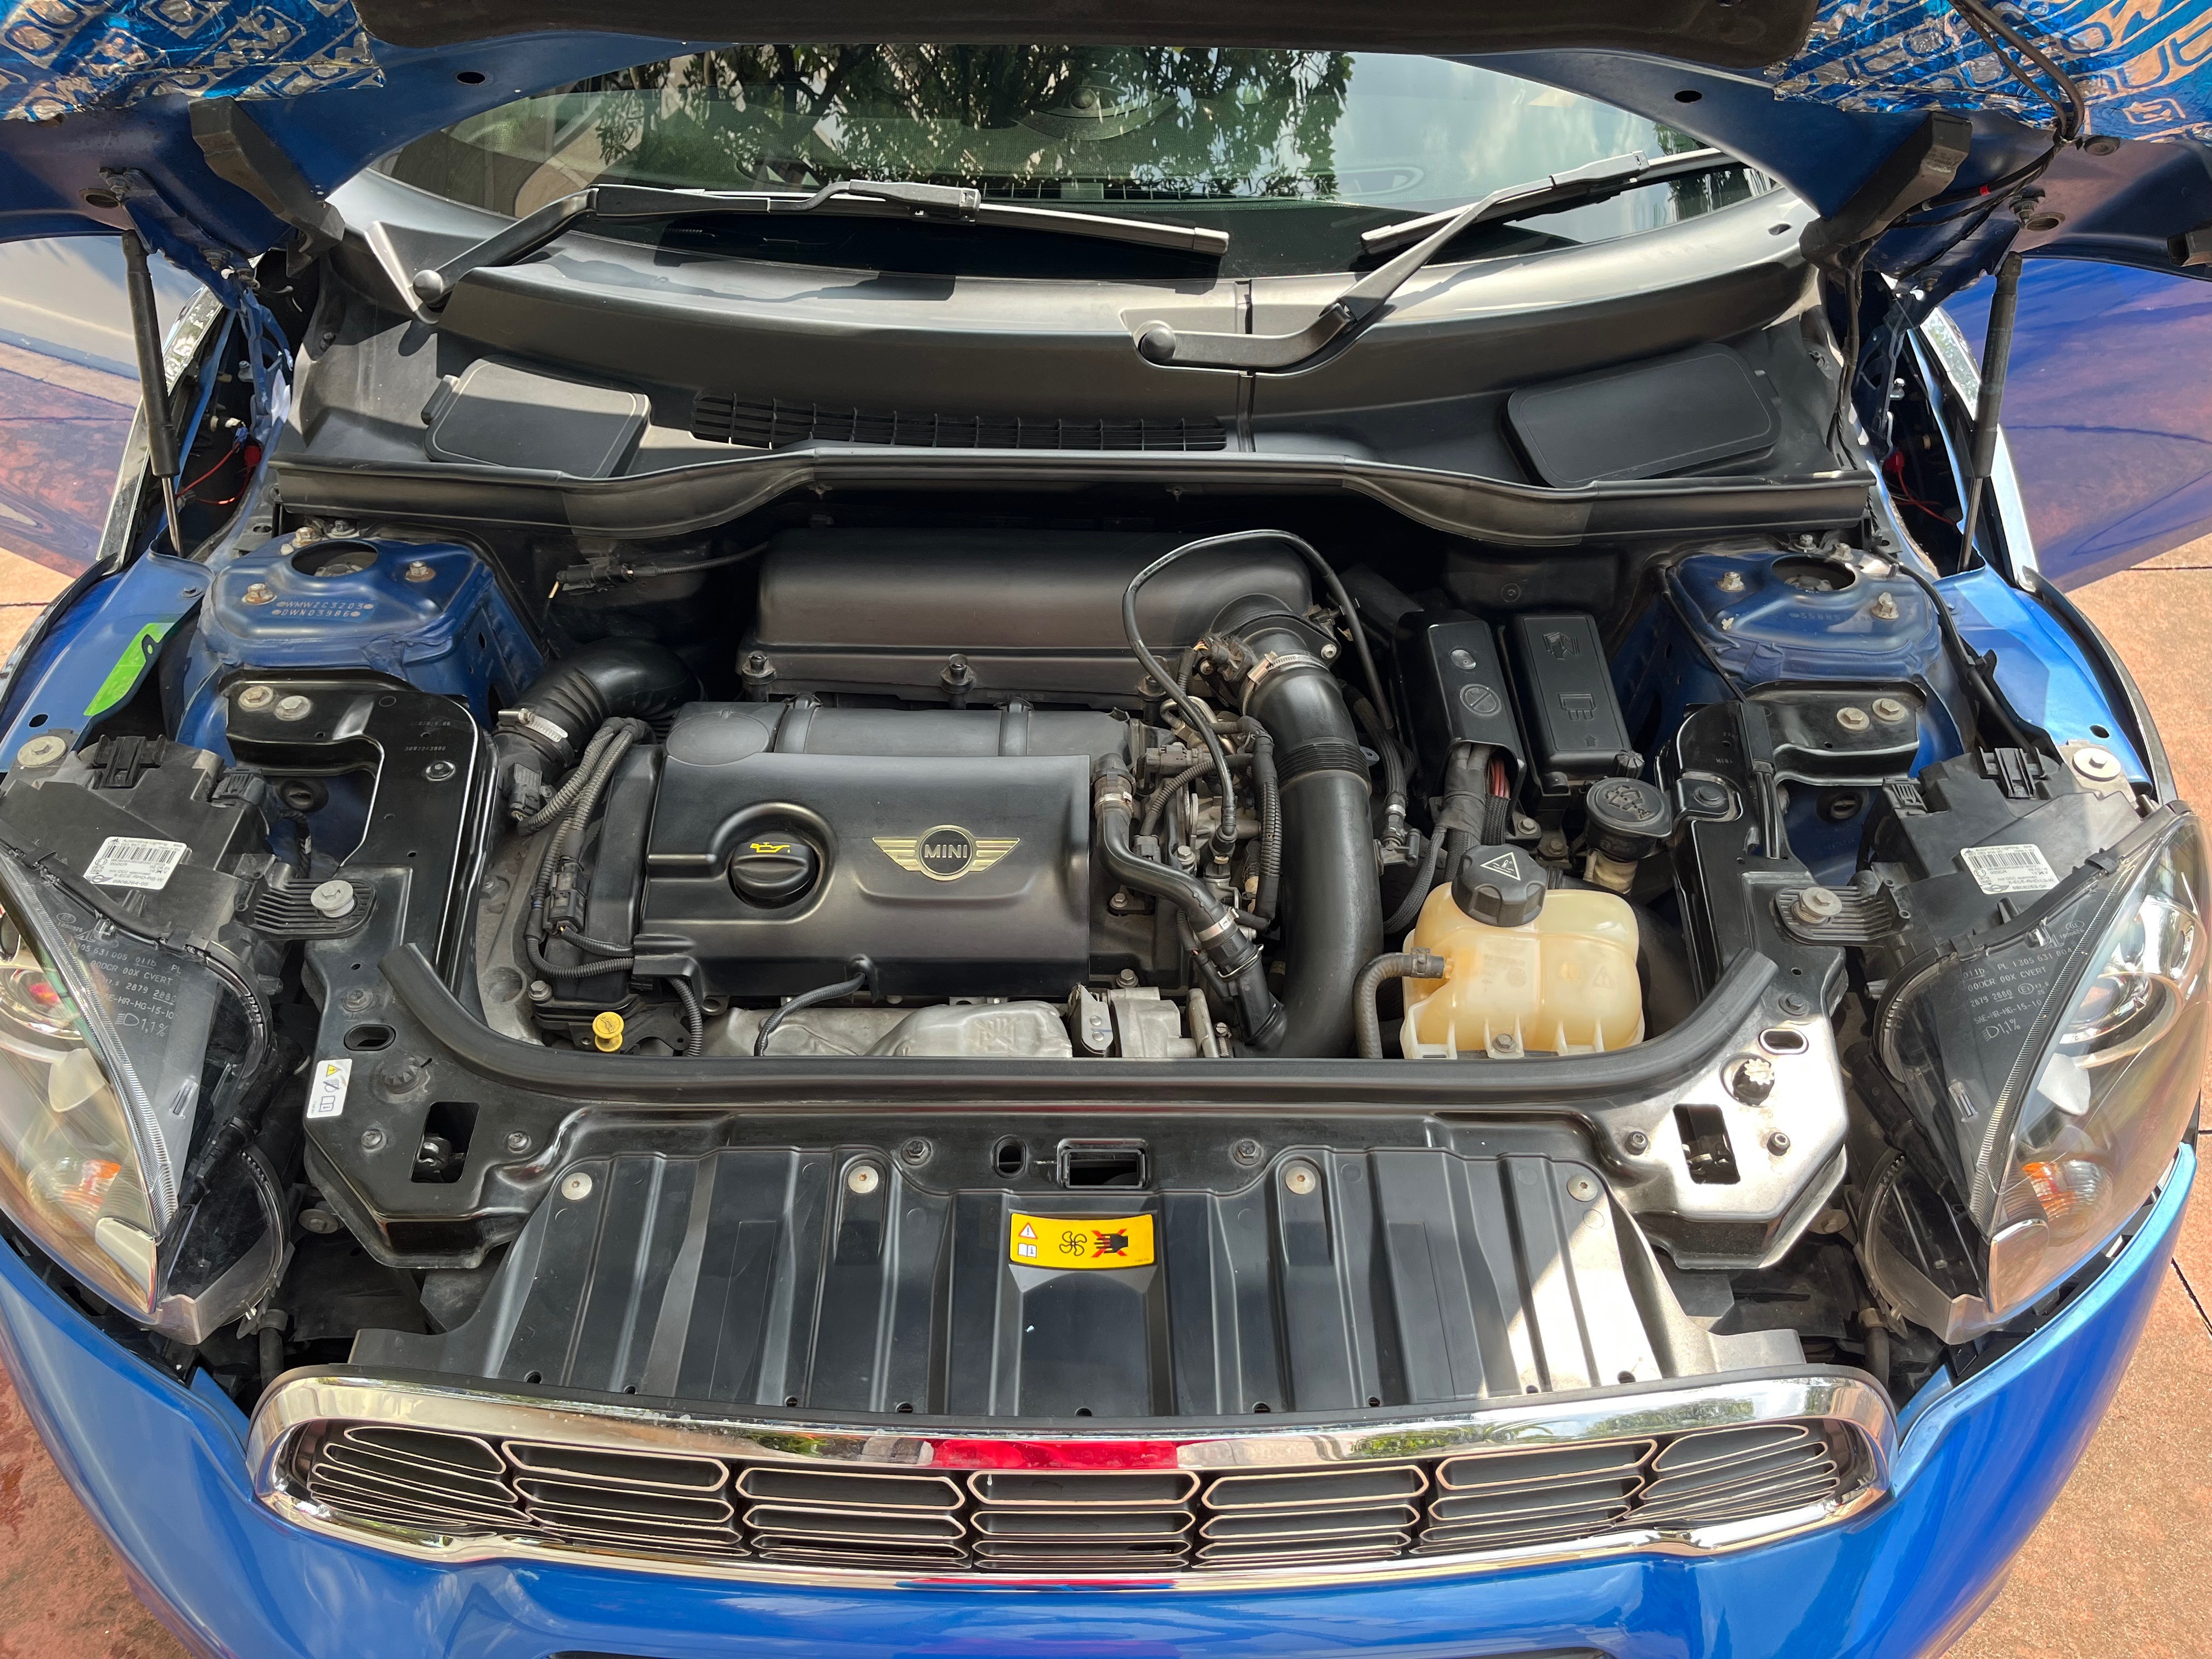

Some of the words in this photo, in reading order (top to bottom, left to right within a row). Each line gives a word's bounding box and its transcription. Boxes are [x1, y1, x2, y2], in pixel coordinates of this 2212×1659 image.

[924, 844, 967, 858] MINI
[93, 947, 109, 956] 631
[111, 952, 128, 961] 005
[171, 964, 182, 974] PL
[2018, 957, 2035, 966] 305
[2038, 953, 2053, 962] 631
[2056, 947, 2072, 957] 004
[91, 960, 119, 972] 00DCR
[123, 967, 140, 977] 00X
[144, 972, 173, 985] CVERT
[1967, 978, 1996, 992] 00DCR
[2000, 973, 2017, 983] 00X
[2020, 966, 2046, 978] CVERT
[126, 983, 149, 994] 2879
[1970, 996, 1989, 1007] 2879
[1991, 989, 2012, 1000] 2880
[1974, 999, 2041, 1024] SAE-HR-HG-15-10
[142, 1018, 168, 1037] 1,1%
[1997, 1018, 2021, 1035] 1,1%
